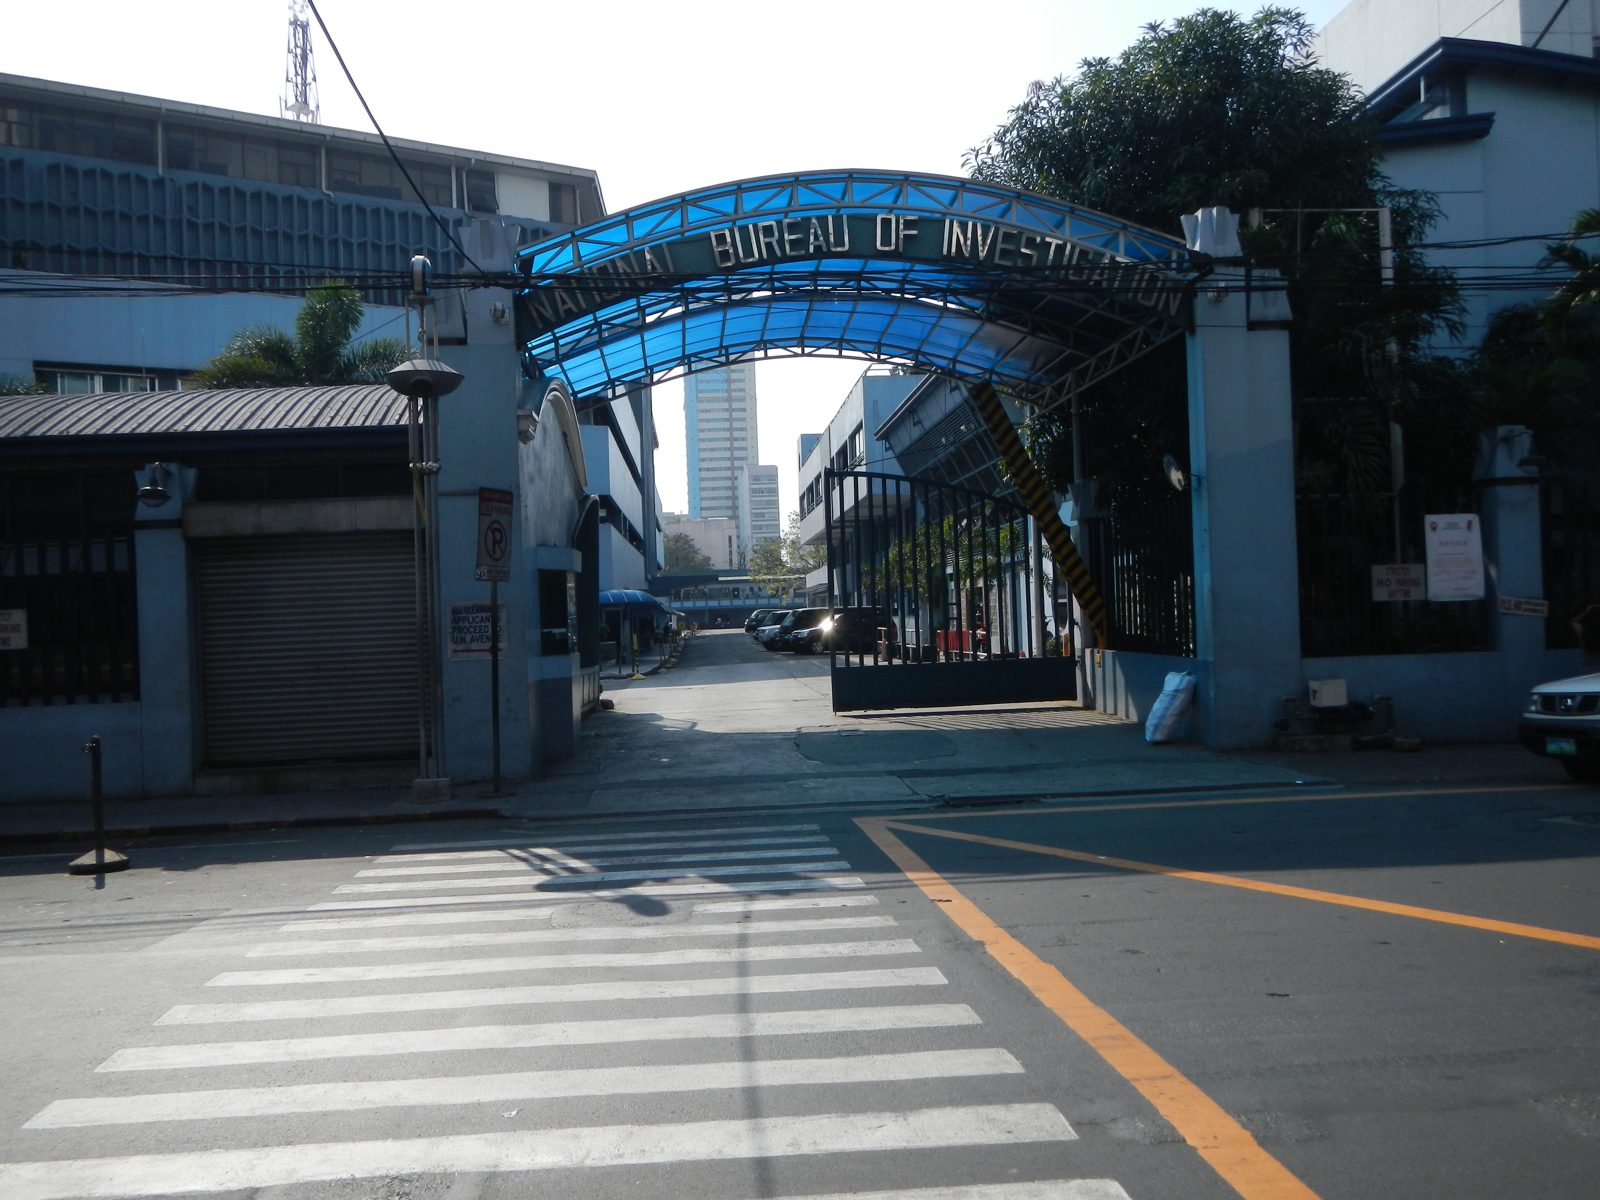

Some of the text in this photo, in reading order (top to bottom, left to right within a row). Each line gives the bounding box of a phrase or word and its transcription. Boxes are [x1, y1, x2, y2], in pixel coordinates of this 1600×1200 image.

[709, 213, 850, 268] BUREAU
[875, 212, 919, 252] OF
[942, 218, 1184, 317] INVESTIGATION
[452, 625, 489, 634] PROCEED
